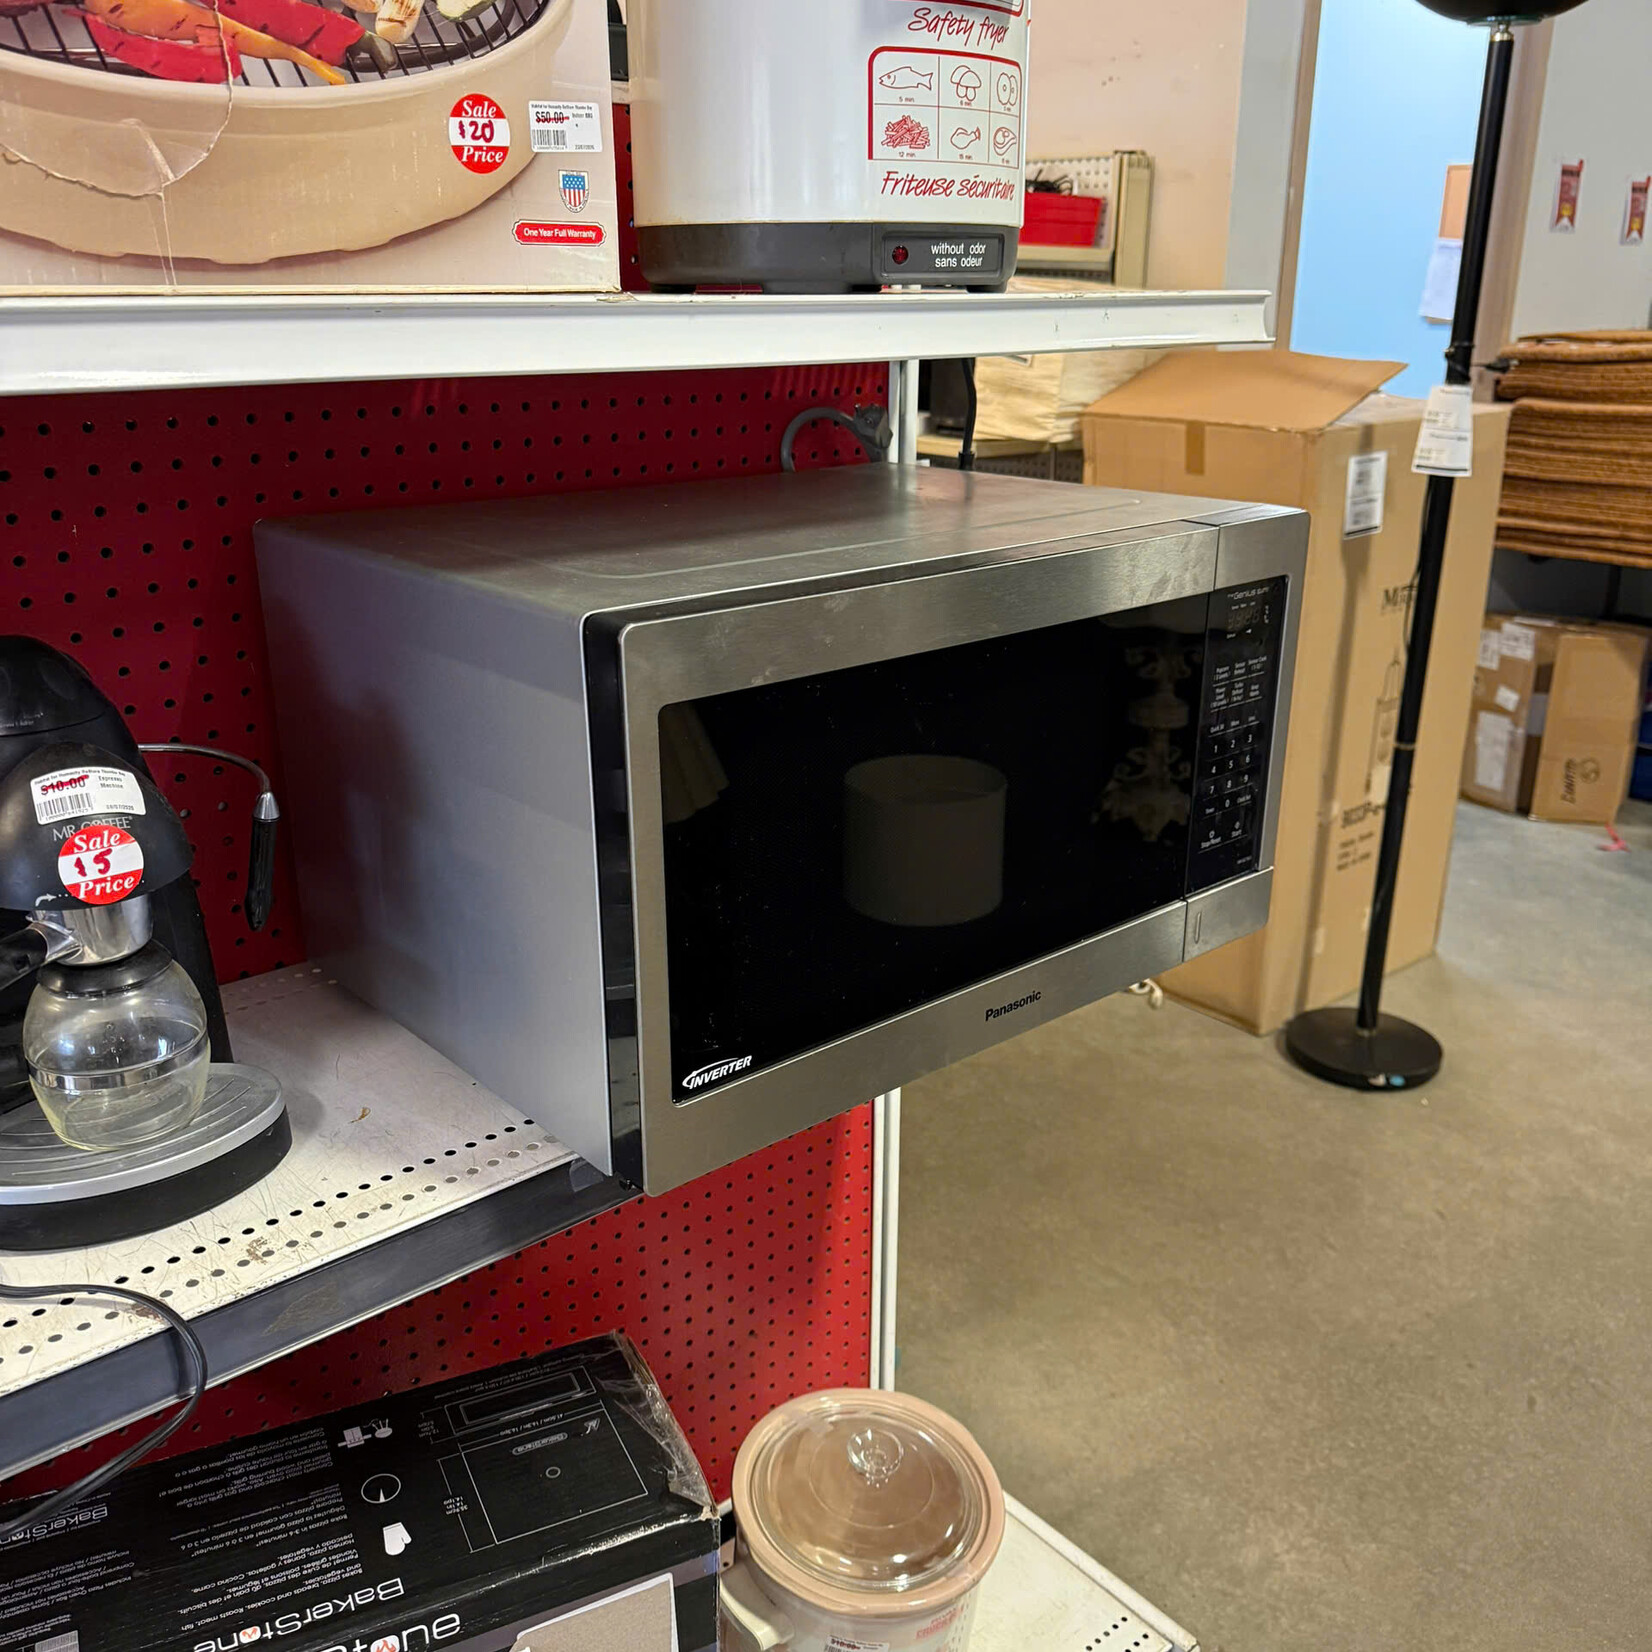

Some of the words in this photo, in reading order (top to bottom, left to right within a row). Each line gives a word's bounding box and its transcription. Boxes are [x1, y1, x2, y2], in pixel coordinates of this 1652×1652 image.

[908, 7, 976, 47] Safety
[977, 16, 1010, 51] fryer
[462, 100, 497, 119] Sale
[535, 110, 565, 124] $50.00
[458, 120, 495, 144] $20
[461, 146, 504, 164] Price
[880, 171, 956, 198] Friteuse
[956, 174, 1015, 201] sécuritaire
[524, 228, 539, 237] One
[539, 228, 554, 237] Year
[554, 229, 567, 238] Full
[568, 229, 596, 240] Warranty
[931, 242, 964, 255] without
[969, 243, 986, 255] odor
[935, 258, 958, 268] sans
[960, 256, 983, 268] odeur
[40, 776, 86, 796] $10.00
[73, 830, 121, 854] Sale
[78, 875, 135, 900] Price
[984, 989, 1042, 1023] Panasonic
[686, 1055, 752, 1090] INVERTER
[341, 1568, 362, 1578] Bakes
[346, 1563, 361, 1572] and
[276, 1591, 292, 1600] and
[293, 1582, 319, 1594] breads
[194, 1578, 404, 1652] BakerStone
[219, 1607, 244, 1618] Roasts
